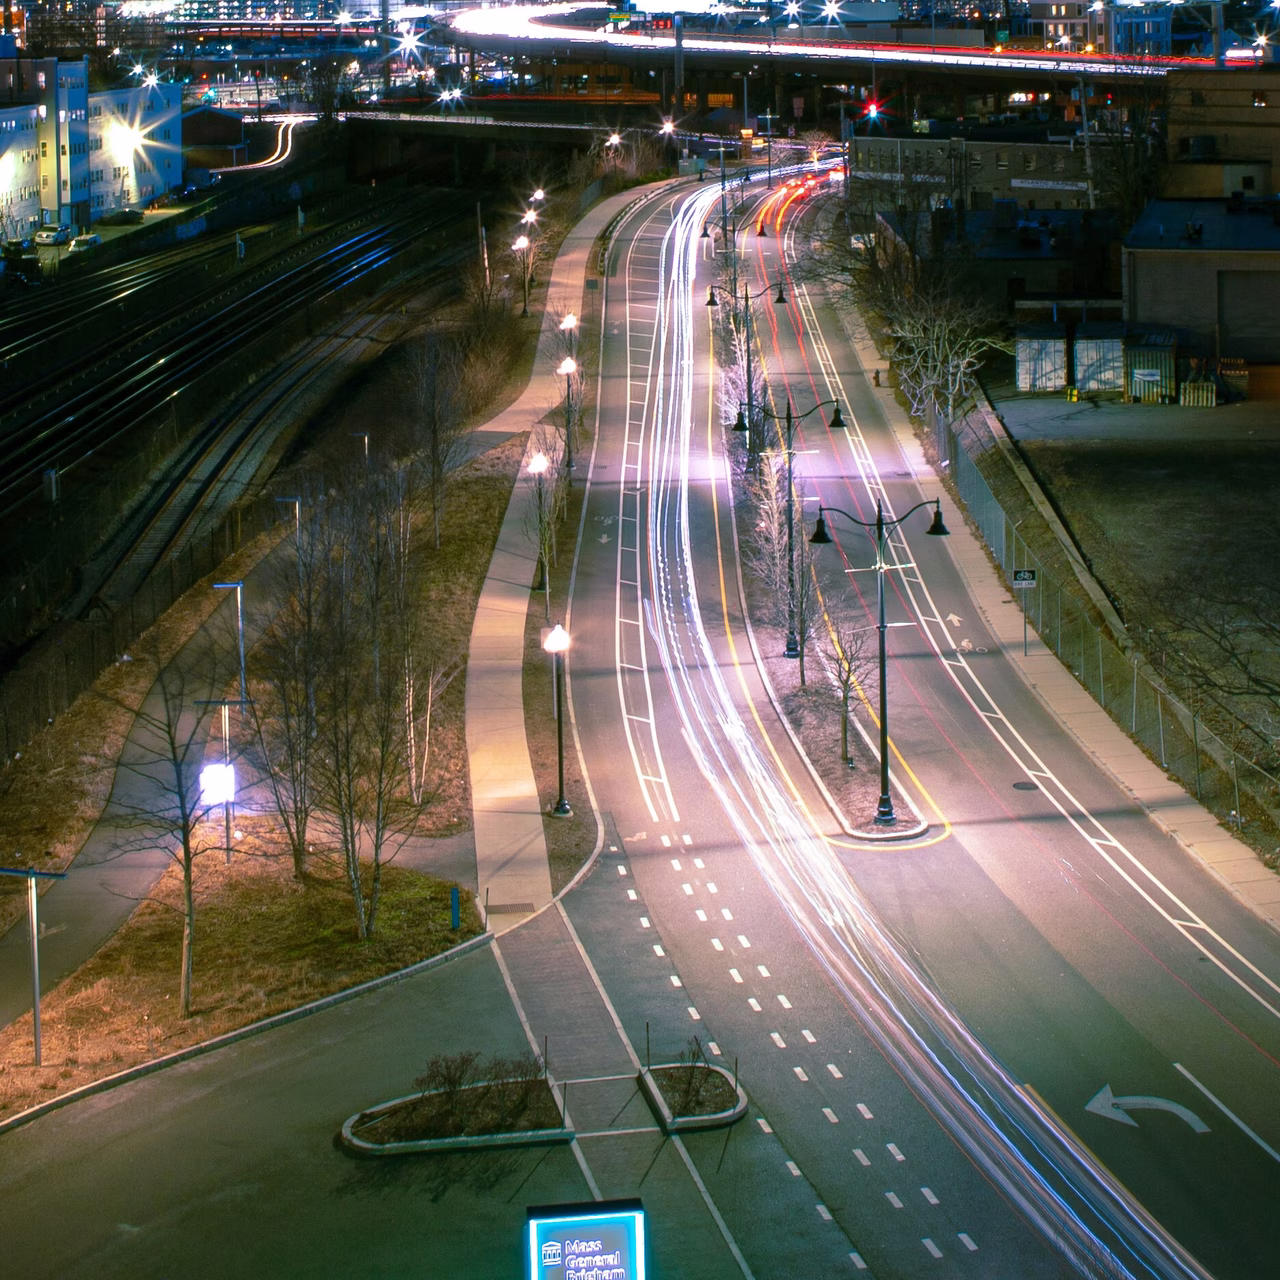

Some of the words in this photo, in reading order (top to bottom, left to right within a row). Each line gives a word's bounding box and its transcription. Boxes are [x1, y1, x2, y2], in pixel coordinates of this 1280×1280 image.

[565, 1239, 602, 1254] Mass
[565, 1251, 620, 1268] General
[566, 1268, 625, 1280] Brigham
